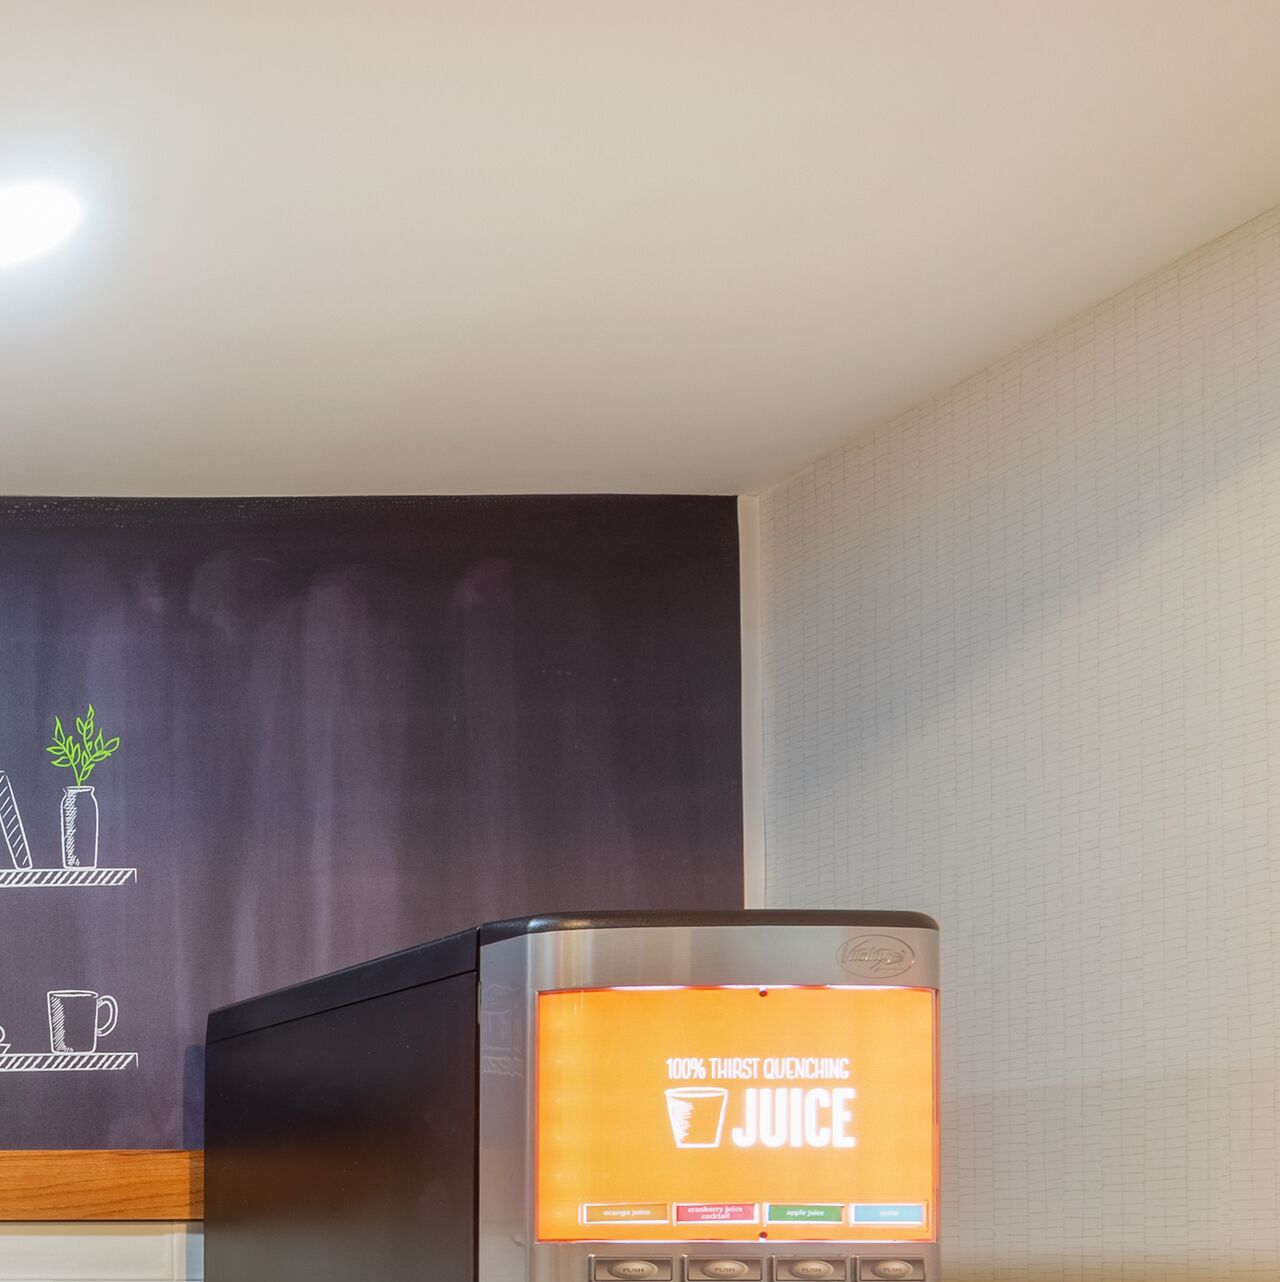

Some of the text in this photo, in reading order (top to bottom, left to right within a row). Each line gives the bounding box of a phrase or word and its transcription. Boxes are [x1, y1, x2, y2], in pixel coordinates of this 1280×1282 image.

[665, 1057, 850, 1080] 100% THIRST QUENCHING
[731, 1087, 856, 1148] JUICE
[688, 1206, 723, 1214] cranberry
